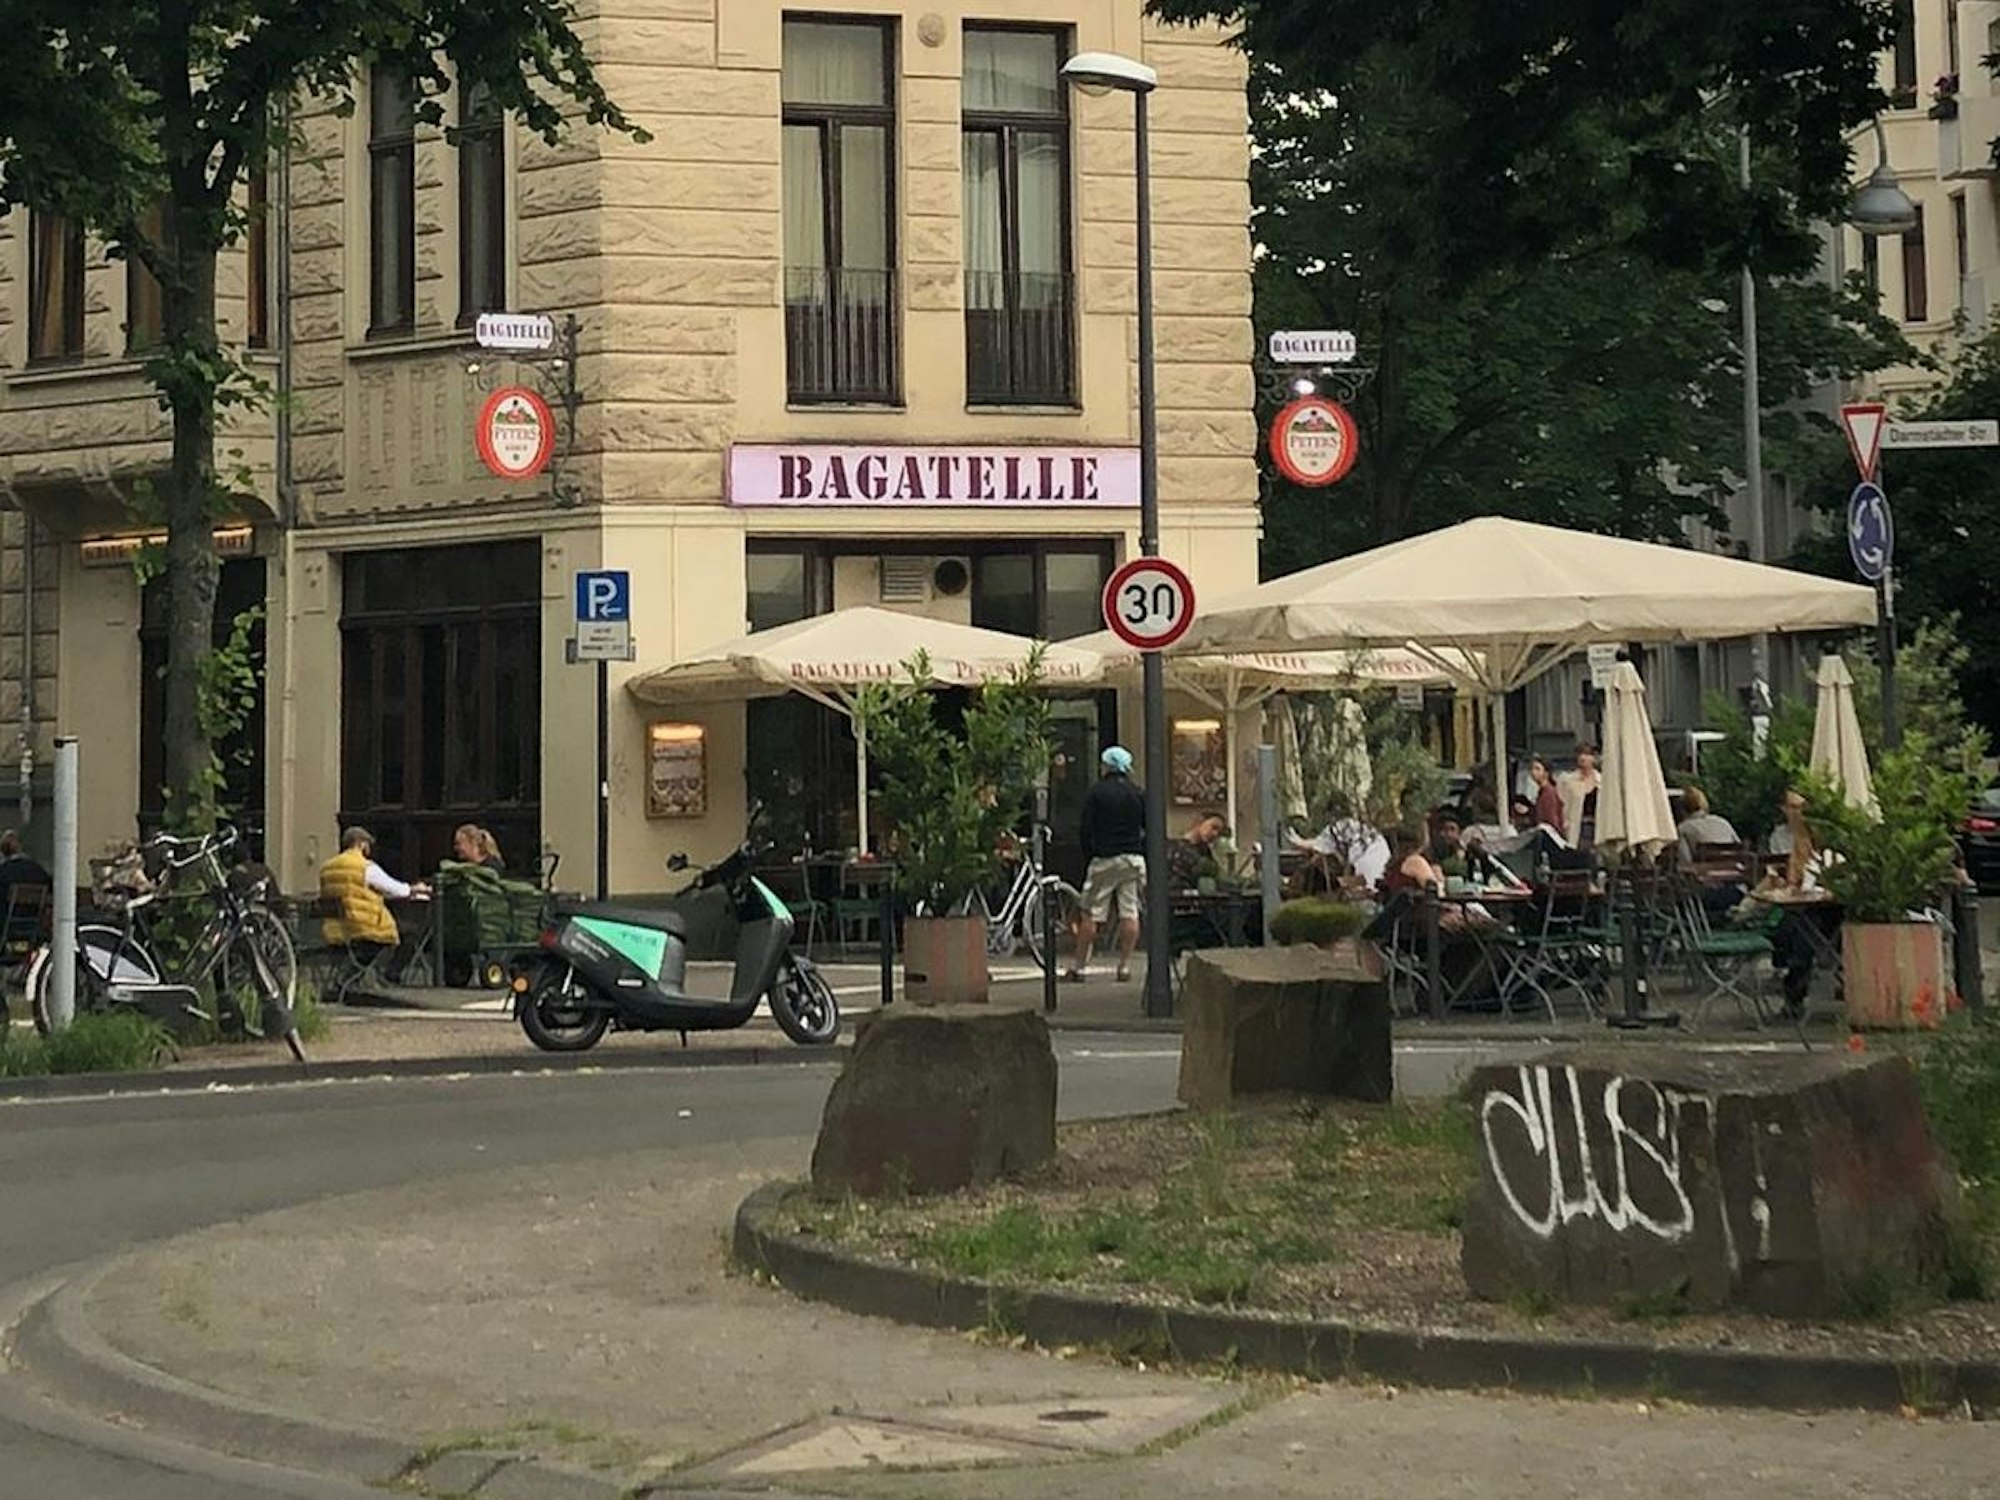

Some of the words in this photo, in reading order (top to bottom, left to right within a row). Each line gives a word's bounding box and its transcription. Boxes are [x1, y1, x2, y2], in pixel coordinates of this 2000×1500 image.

[479, 322, 551, 340] BAGATELLE
[1273, 339, 1354, 354] BAGATELLE
[778, 455, 1100, 501] BAGATELLE
[588, 578, 618, 619] P
[1123, 583, 1175, 625] 30
